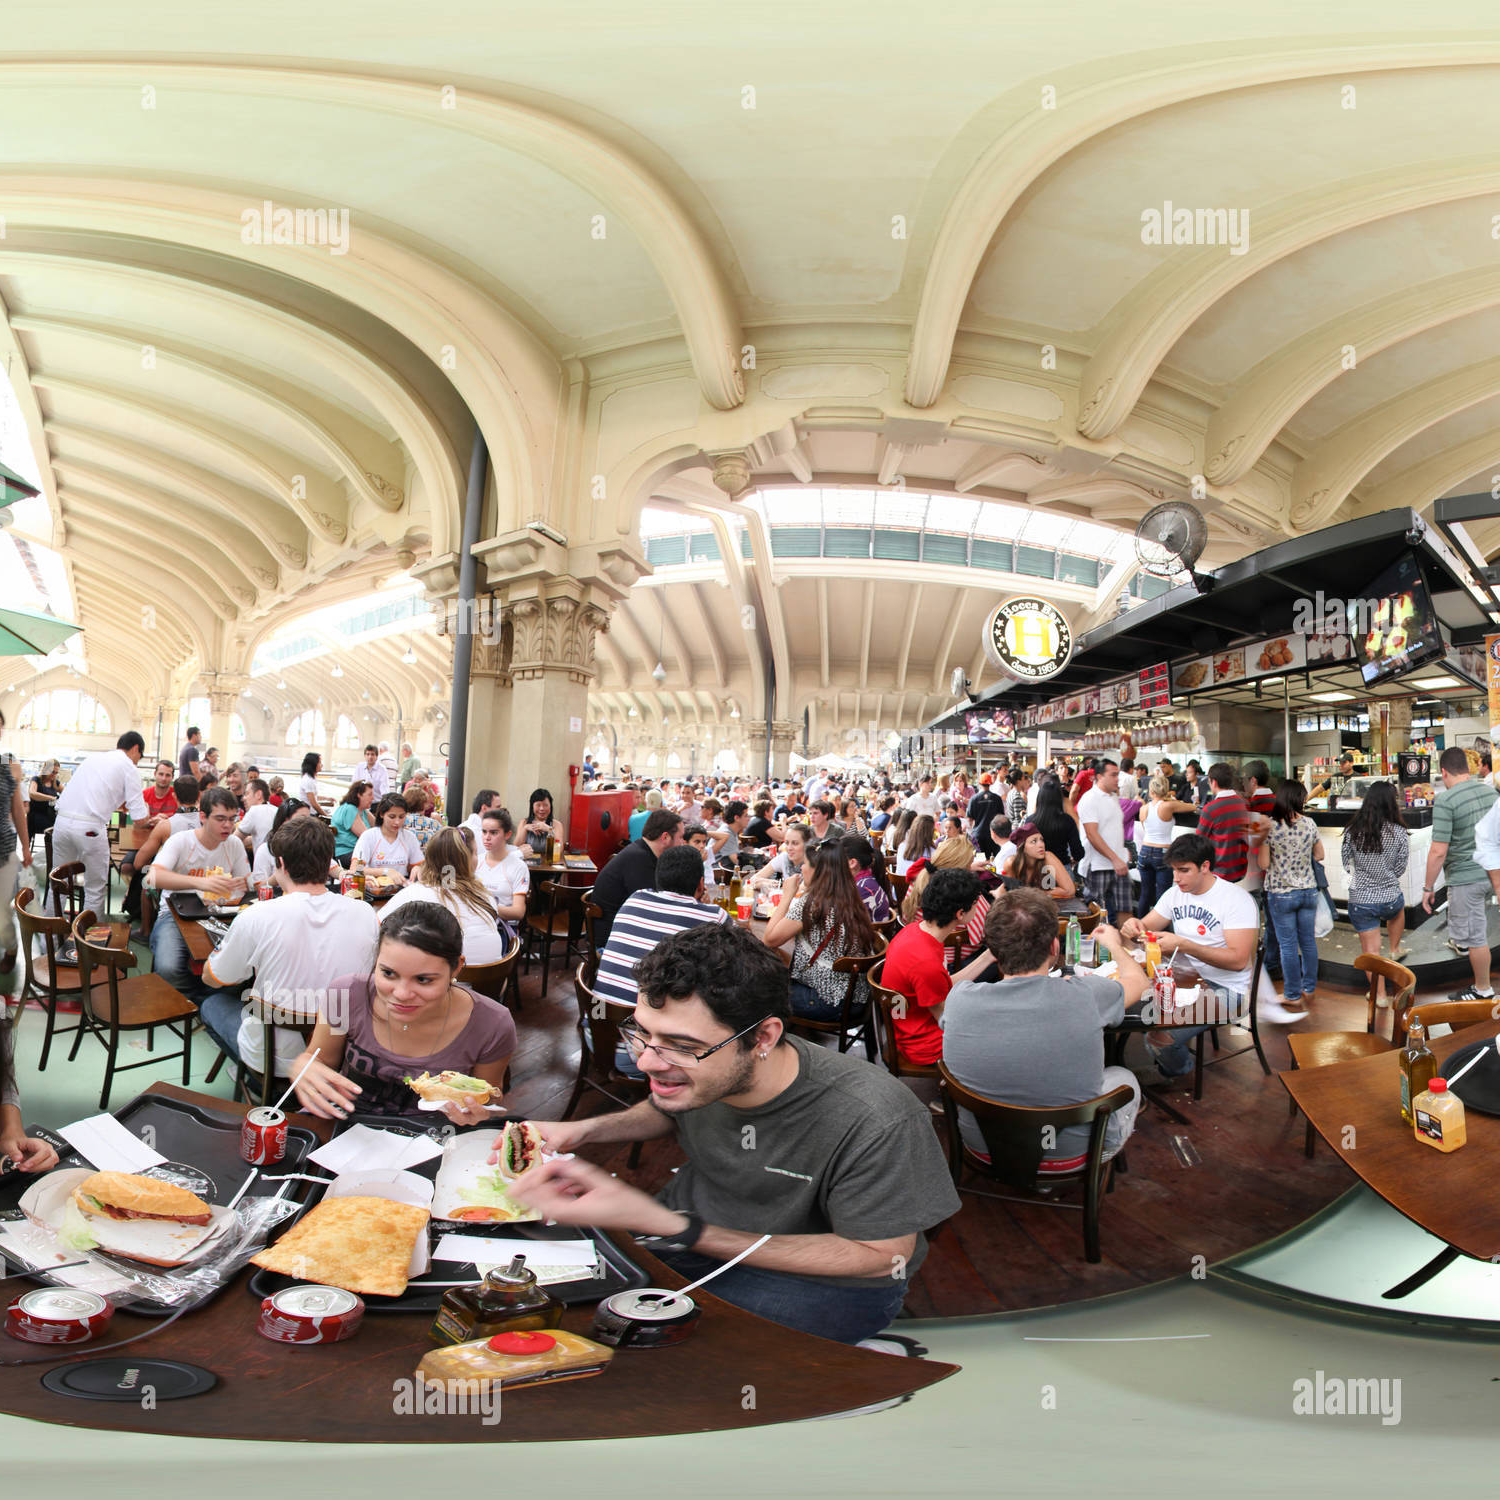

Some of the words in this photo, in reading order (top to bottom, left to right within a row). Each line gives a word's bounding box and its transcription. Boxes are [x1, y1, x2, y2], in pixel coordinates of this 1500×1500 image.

[1001, 602, 1039, 618] Hocca
[1041, 604, 1061, 624] Bar
[1010, 615, 1055, 657] H
[1011, 660, 1036, 675] desde
[117, 1368, 140, 1389] Canon
